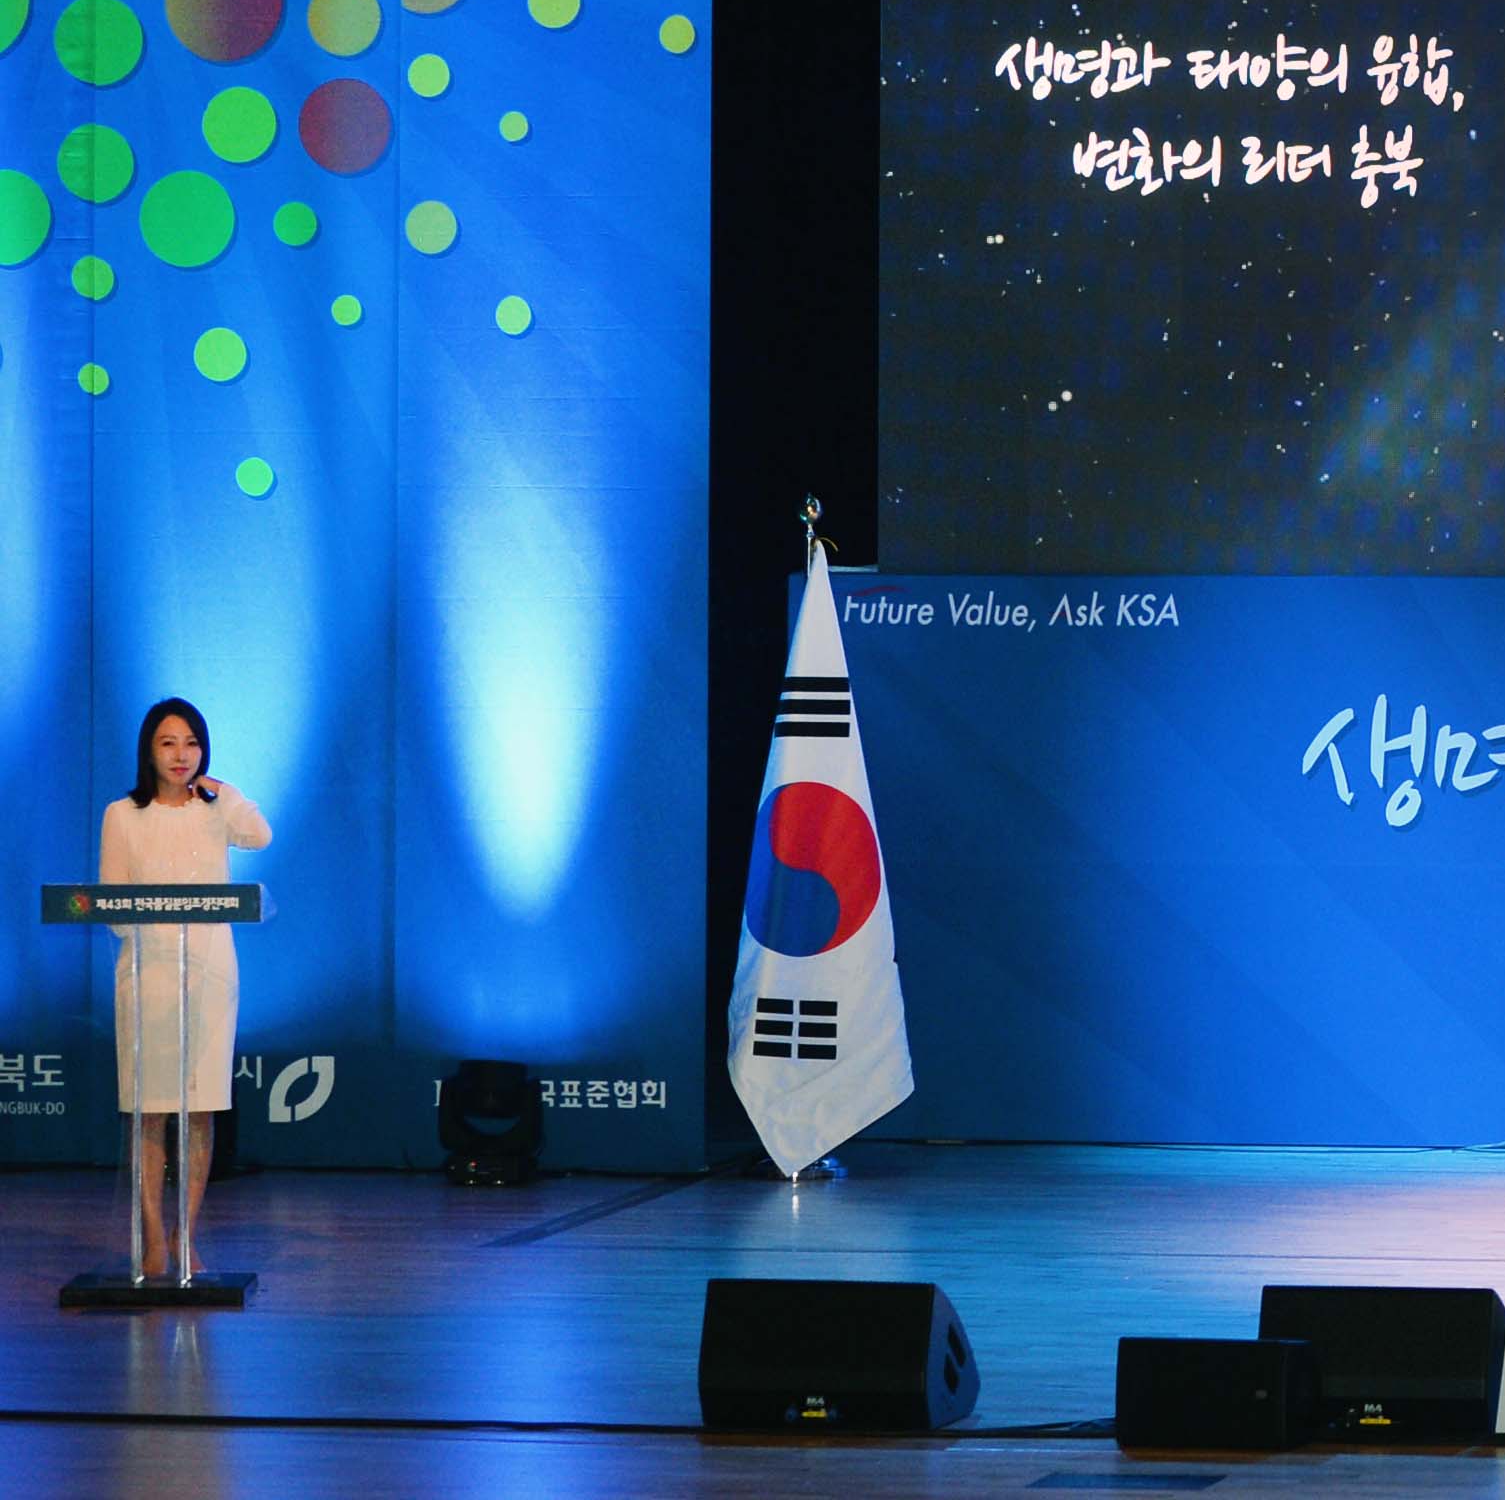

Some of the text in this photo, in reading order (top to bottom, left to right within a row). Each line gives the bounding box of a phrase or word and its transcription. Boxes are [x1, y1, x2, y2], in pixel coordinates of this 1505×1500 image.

[996, 33, 1465, 112] 생명과 태양의 융합,
[1072, 124, 1424, 209] 변화의 리더 충북
[843, 594, 934, 626] Future
[948, 590, 1037, 633] Value,
[1116, 593, 1179, 627] KSA
